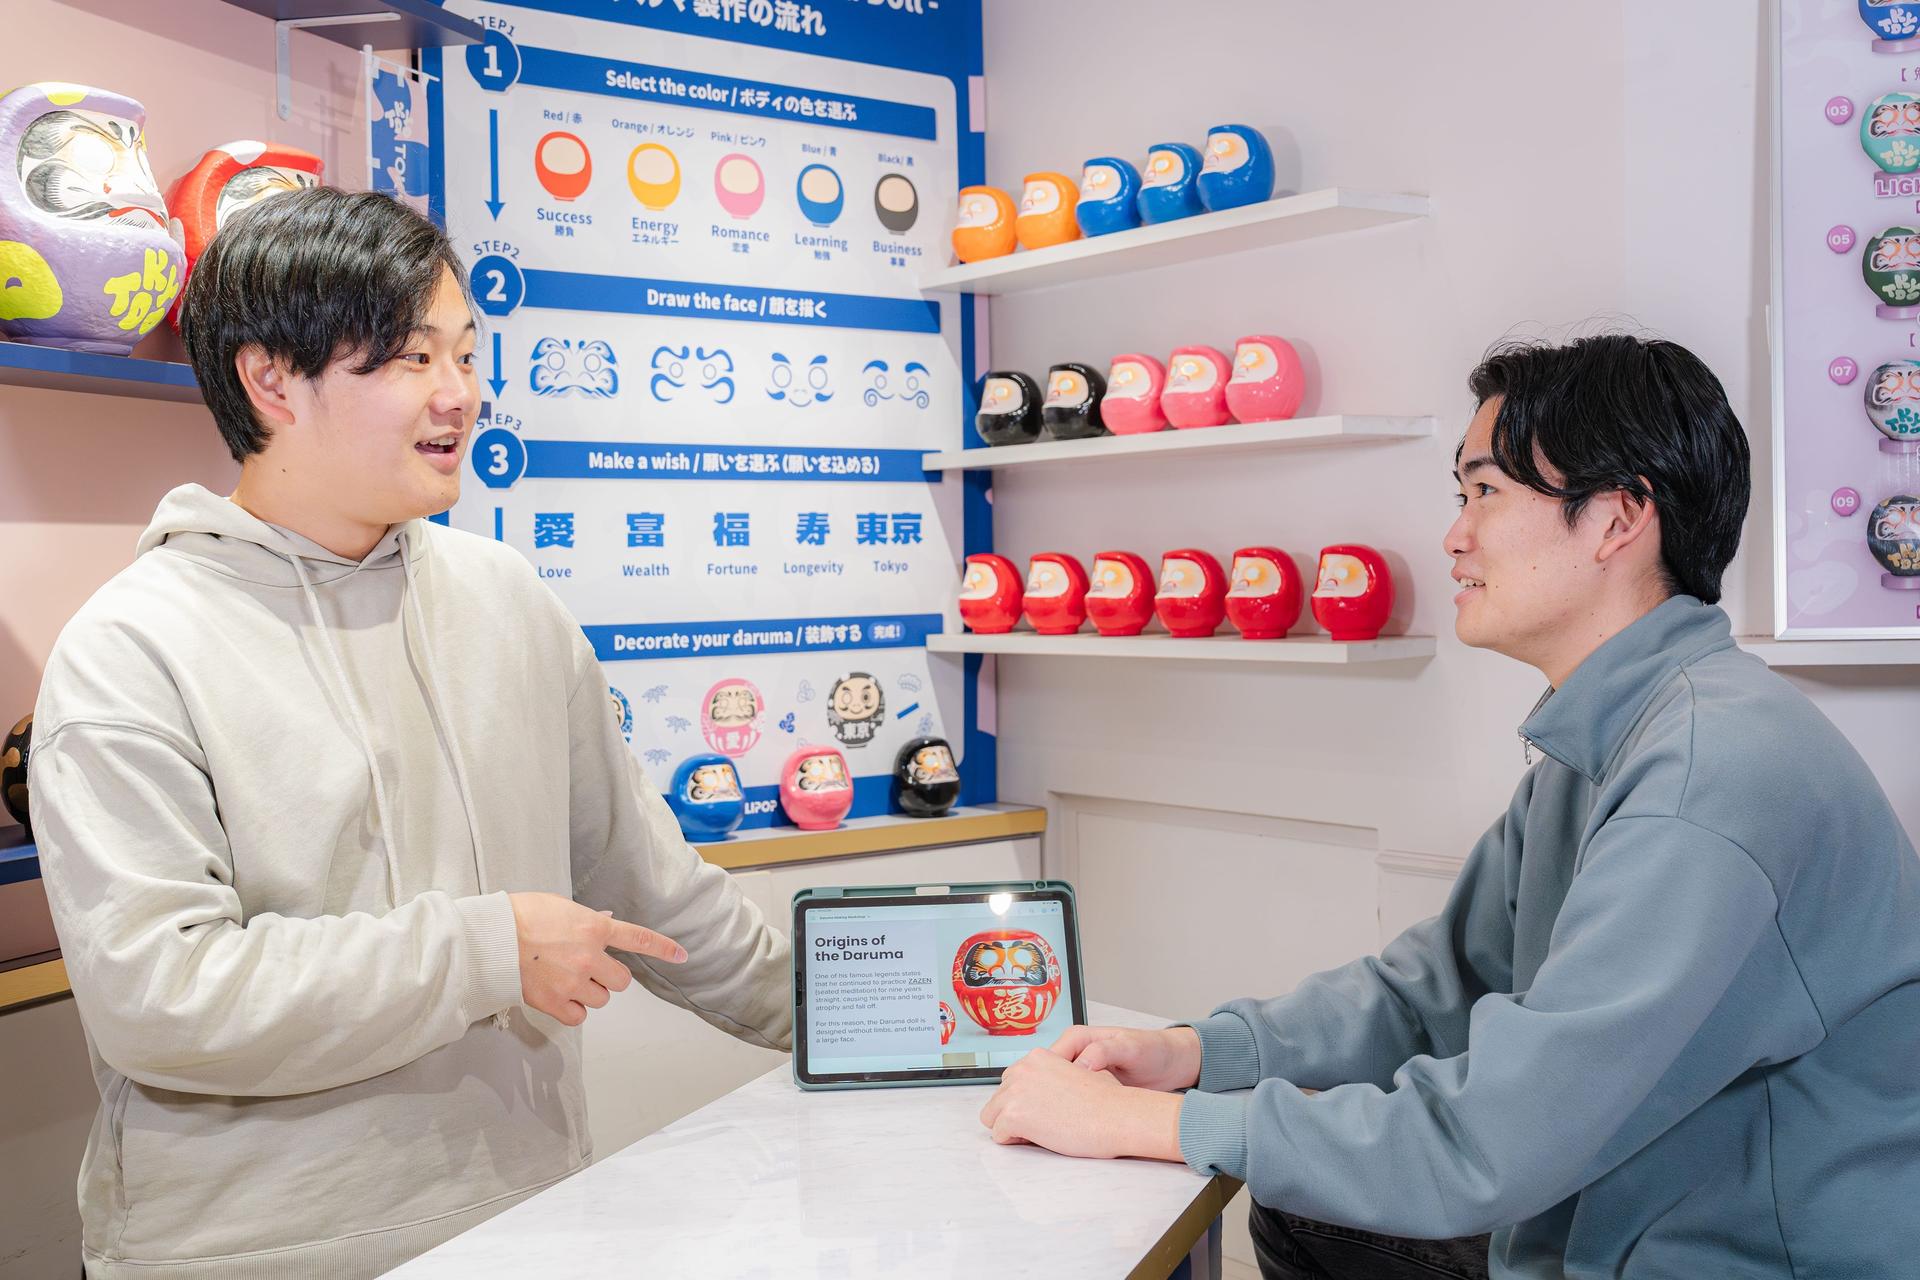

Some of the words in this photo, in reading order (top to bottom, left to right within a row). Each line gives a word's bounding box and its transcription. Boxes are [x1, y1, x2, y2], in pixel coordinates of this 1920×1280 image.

[471, 16, 514, 36] TEP1
[484, 45, 503, 77] 1
[606, 69, 657, 93] Select
[659, 77, 686, 97] the
[688, 83, 729, 104] color
[739, 89, 857, 121] ボディの色を選ぶ
[543, 110, 563, 121] Red
[1830, 105, 1849, 116] 03
[611, 119, 649, 133] Orange
[657, 124, 695, 138] オレンジ
[711, 131, 732, 143] Pink
[802, 143, 821, 155] Blue
[878, 153, 900, 164] Black
[537, 208, 592, 225] Success
[554, 225, 575, 237] 勝負
[632, 217, 679, 236] Energy
[711, 225, 770, 242] Romance
[632, 233, 679, 245] エネルギー
[795, 233, 848, 251] Learning
[1832, 234, 1850, 245] 05
[873, 240, 923, 256] Business
[486, 269, 507, 302] 2
[647, 289, 690, 308] Draw
[693, 292, 721, 310] the
[724, 293, 758, 313] face
[769, 296, 827, 318] 顔を描く
[1833, 366, 1852, 377] 07
[488, 443, 509, 476] 3
[589, 451, 635, 469] Make
[637, 456, 648, 470] a
[651, 452, 690, 470] wish
[1836, 496, 1855, 507] 09
[534, 512, 575, 549] 愛
[626, 512, 664, 547] 富
[713, 512, 750, 547] 福
[796, 512, 830, 545] 寿
[856, 512, 922, 545] 東京
[538, 566, 572, 578] Love
[622, 563, 670, 577] Wealth
[707, 563, 758, 575] Fortune
[783, 561, 844, 577] Longevity
[873, 560, 908, 574] Tokyo
[614, 633, 689, 651] Decorate
[692, 633, 730, 651] your
[733, 629, 793, 646] daruma
[805, 624, 862, 644] 装飾する
[815, 935, 868, 949] Origins
[871, 934, 886, 945] of
[815, 951, 840, 961] the
[843, 950, 904, 960] Daruma
[875, 971, 900, 979] legends
[881, 979, 907, 987] practice
[815, 988, 839, 996] (seated
[840, 987, 877, 995] meditation)
[911, 993, 925, 1001] legs
[816, 1028, 846, 1036] designed
[821, 1036, 838, 1044] large
